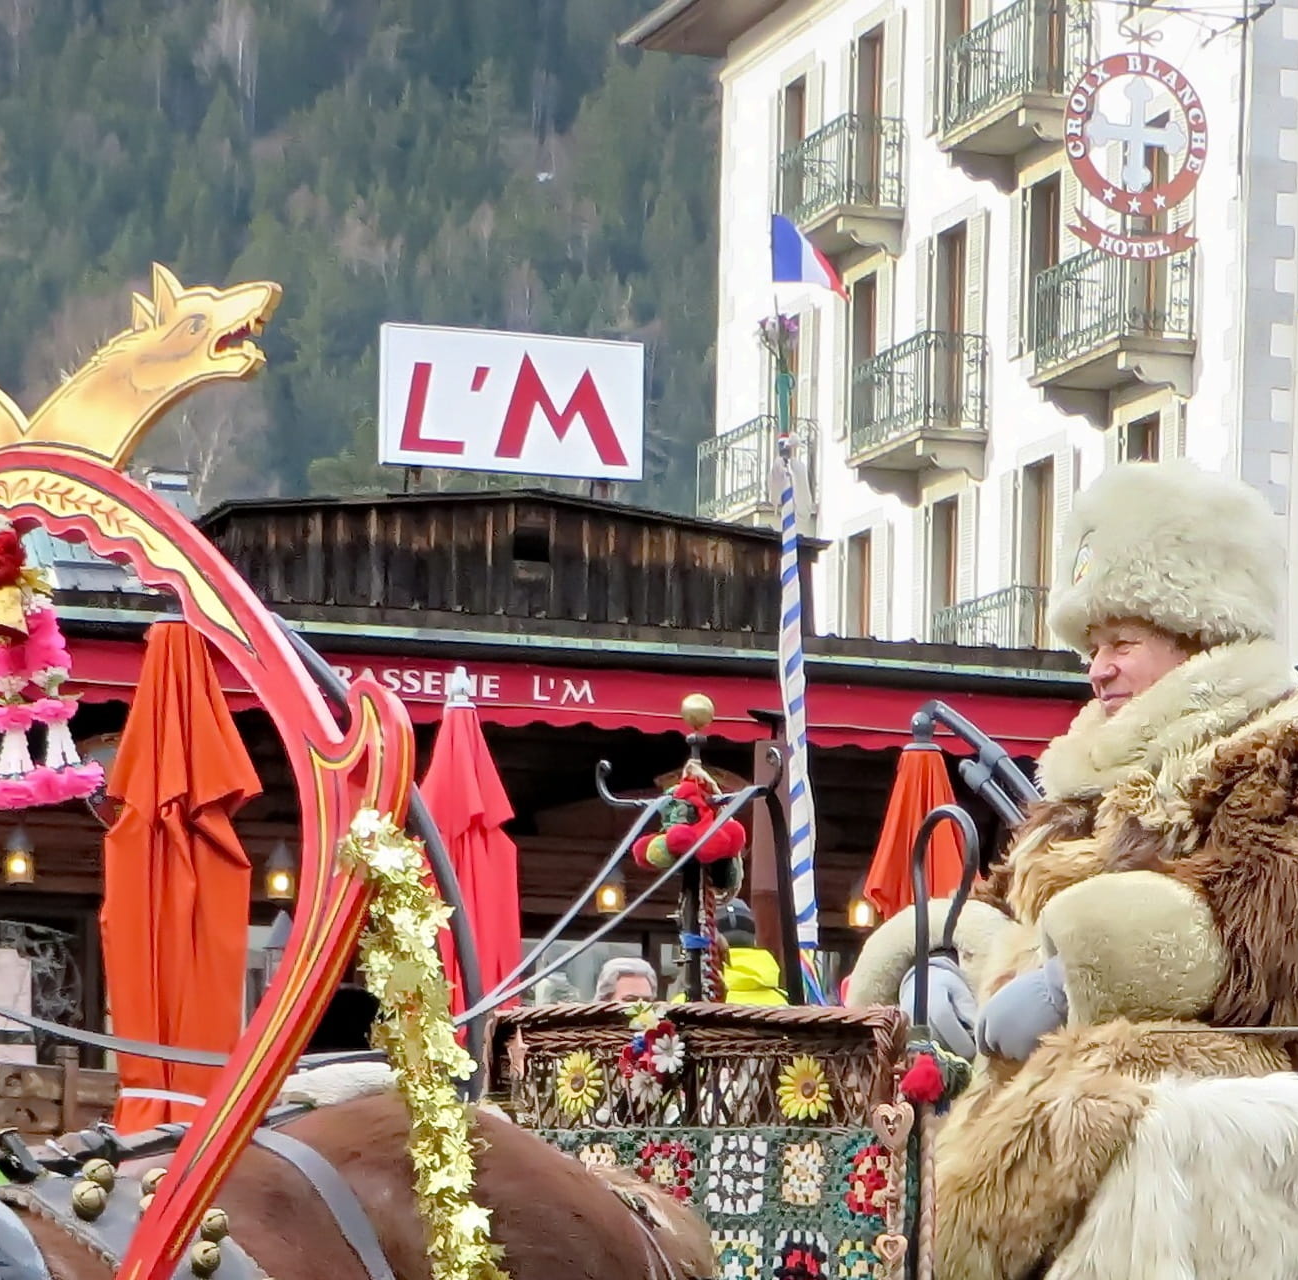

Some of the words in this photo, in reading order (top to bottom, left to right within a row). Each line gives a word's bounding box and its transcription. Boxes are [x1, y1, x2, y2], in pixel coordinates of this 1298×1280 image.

[1068, 64, 1111, 159] CROIX
[1126, 55, 1206, 174] BLANCHE
[1098, 234, 1171, 259] HOTEL
[399, 351, 629, 467] L'M
[533, 675, 595, 705] L'M
